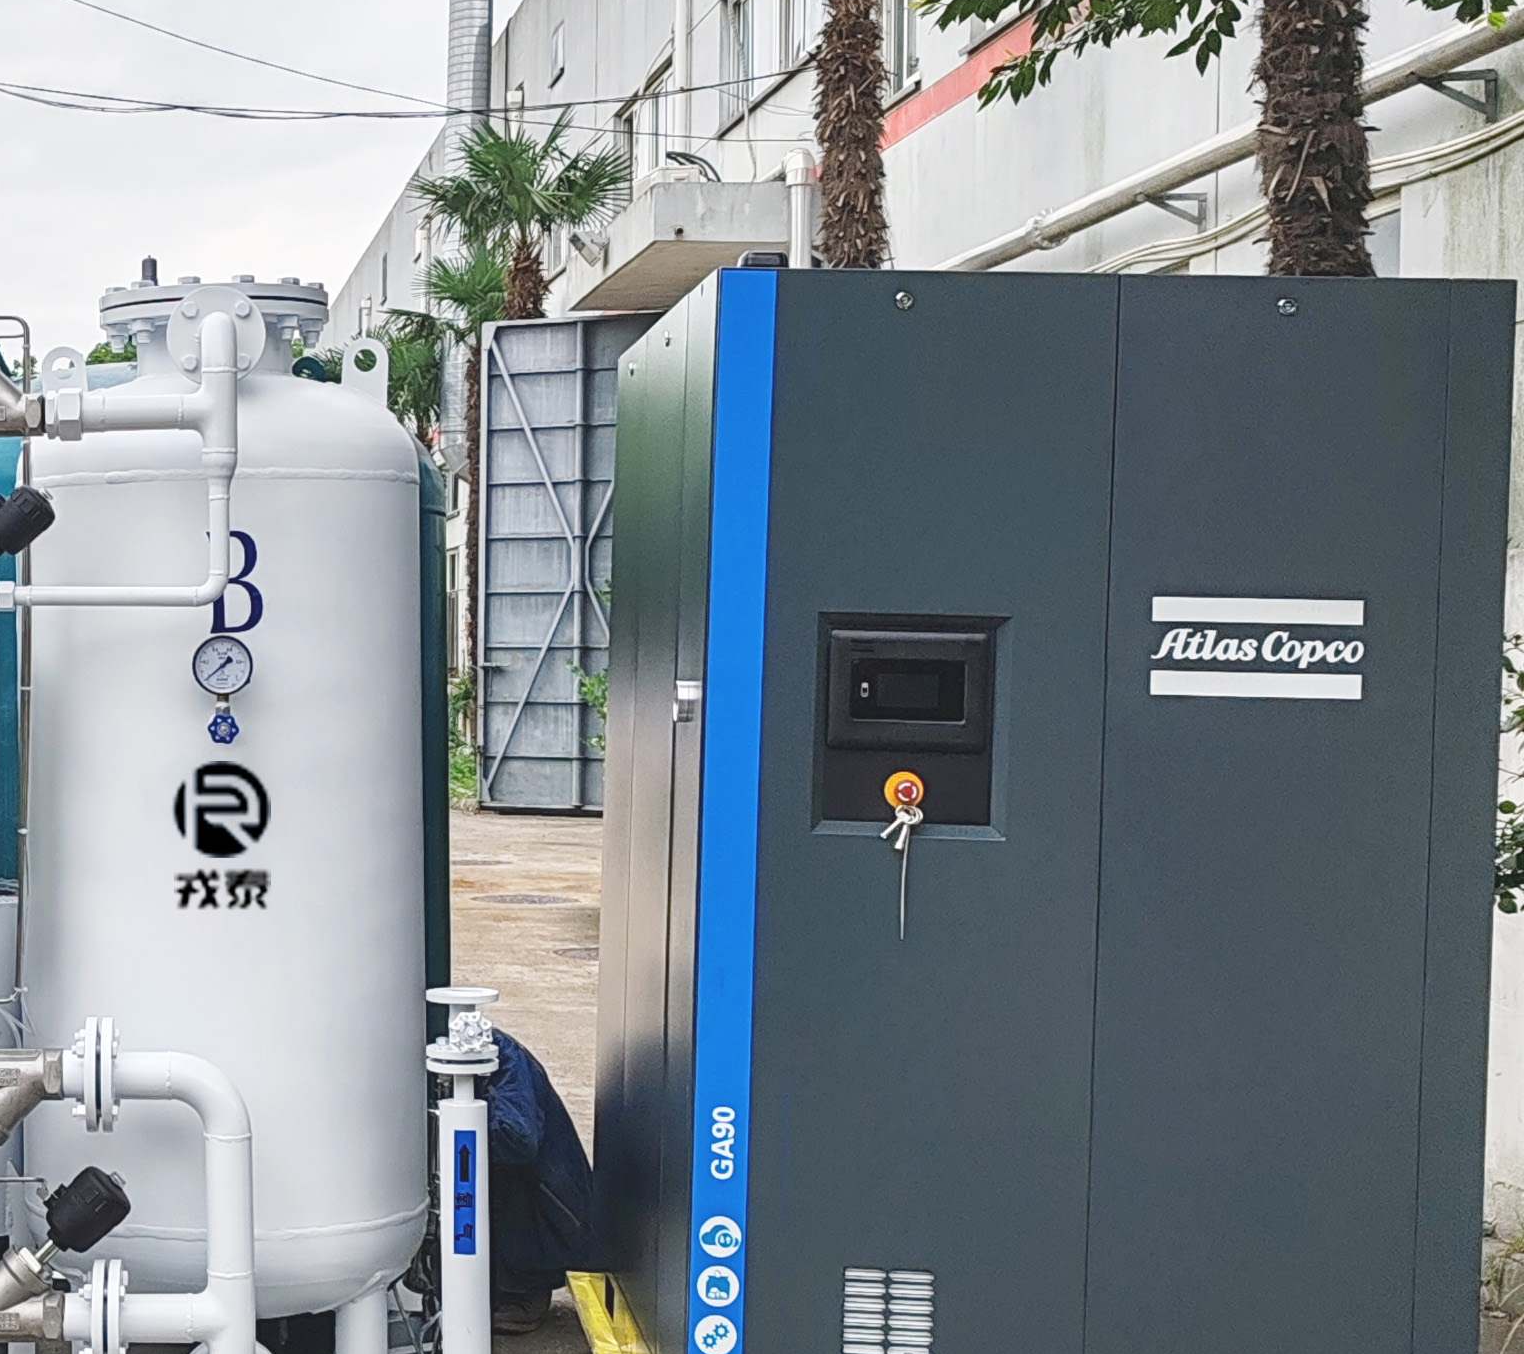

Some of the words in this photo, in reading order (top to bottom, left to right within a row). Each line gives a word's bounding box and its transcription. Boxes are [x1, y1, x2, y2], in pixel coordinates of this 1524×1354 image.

[206, 531, 264, 634] B
[1151, 628, 1259, 662] Atlas
[1261, 631, 1365, 669] Copco
[710, 1106, 736, 1180] GA90
